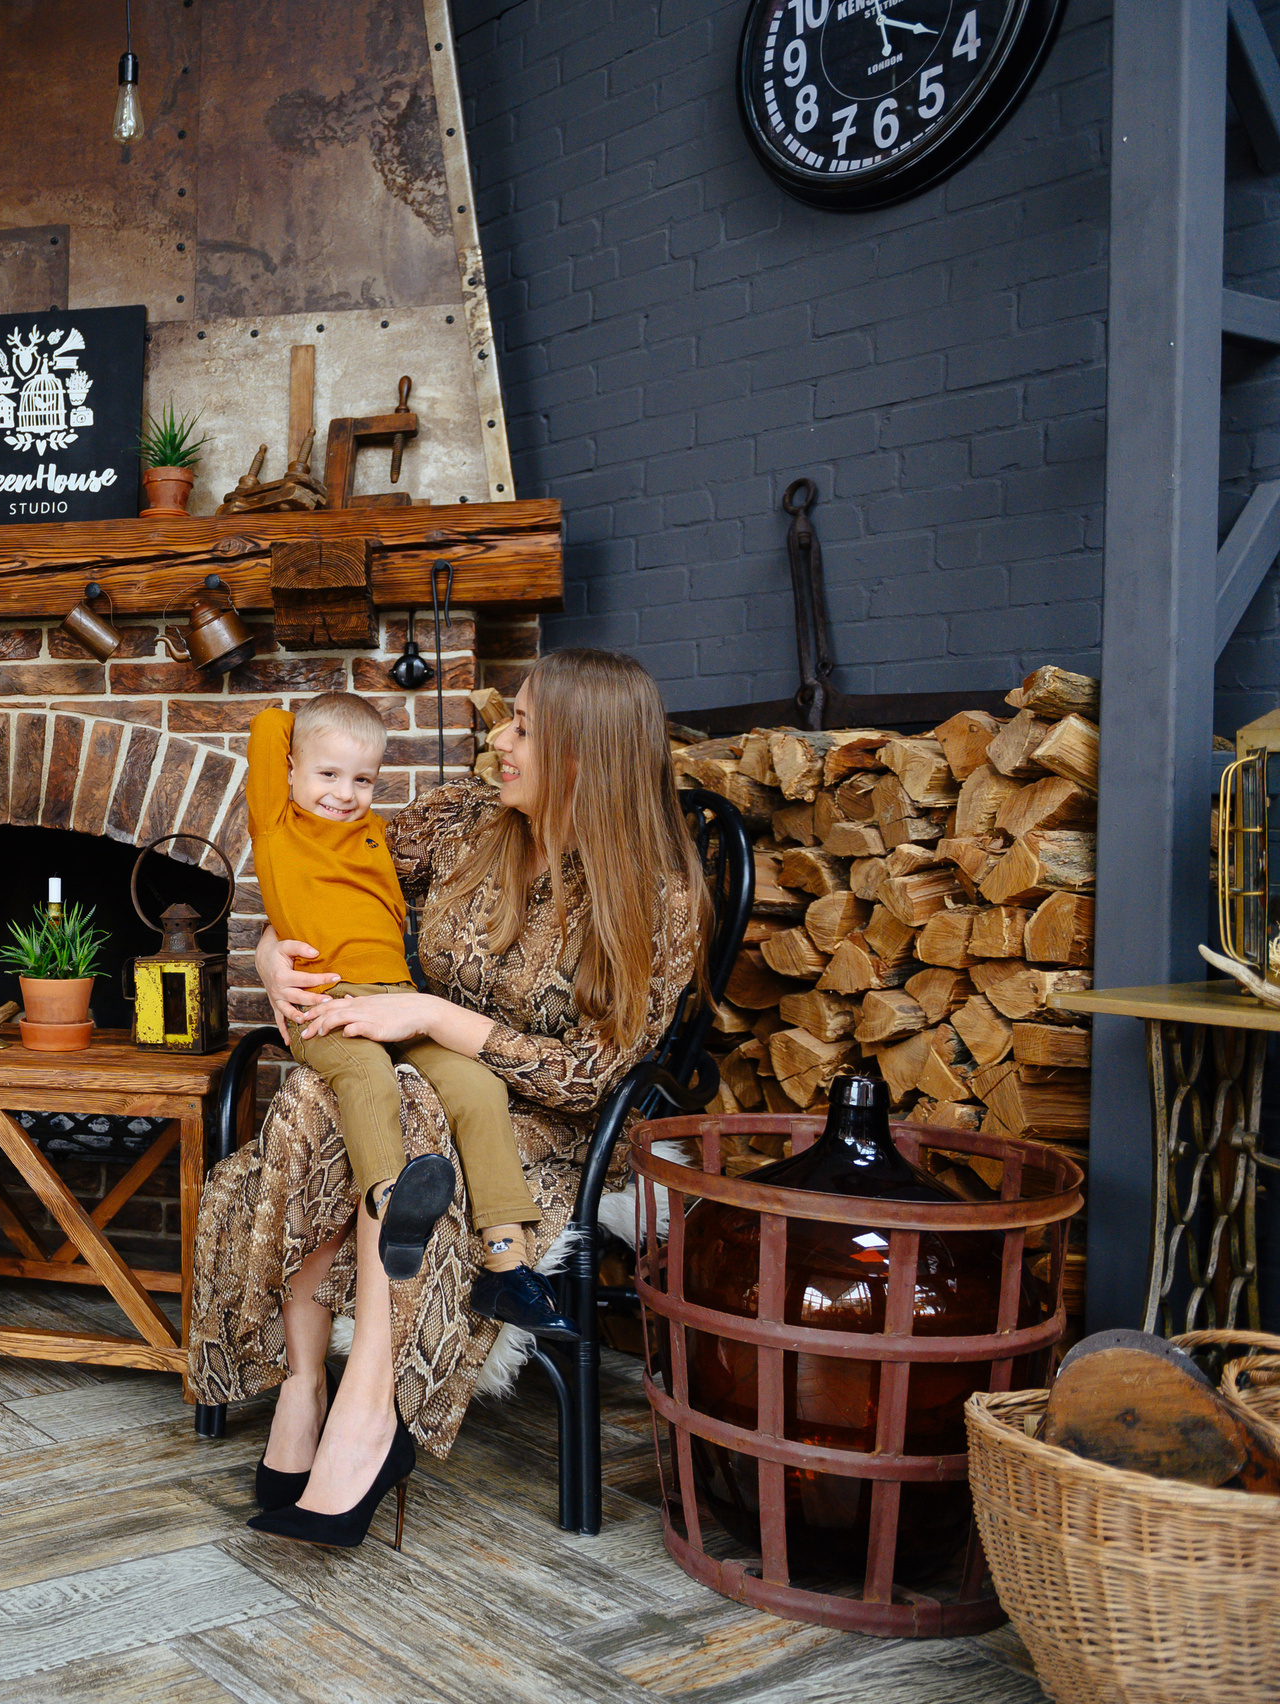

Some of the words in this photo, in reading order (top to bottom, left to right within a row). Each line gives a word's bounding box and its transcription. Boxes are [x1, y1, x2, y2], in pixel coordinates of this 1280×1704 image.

[788, 0, 829, 35] 10
[864, 0, 903, 19] STTIO
[952, 9, 981, 62] 4
[783, 39, 807, 87] 9
[867, 52, 903, 76] LONDON
[795, 84, 819, 133] 8
[918, 64, 945, 119] 5
[832, 104, 858, 156] 7
[873, 98, 899, 149] 6
[9, 501, 68, 515] STUDIO
